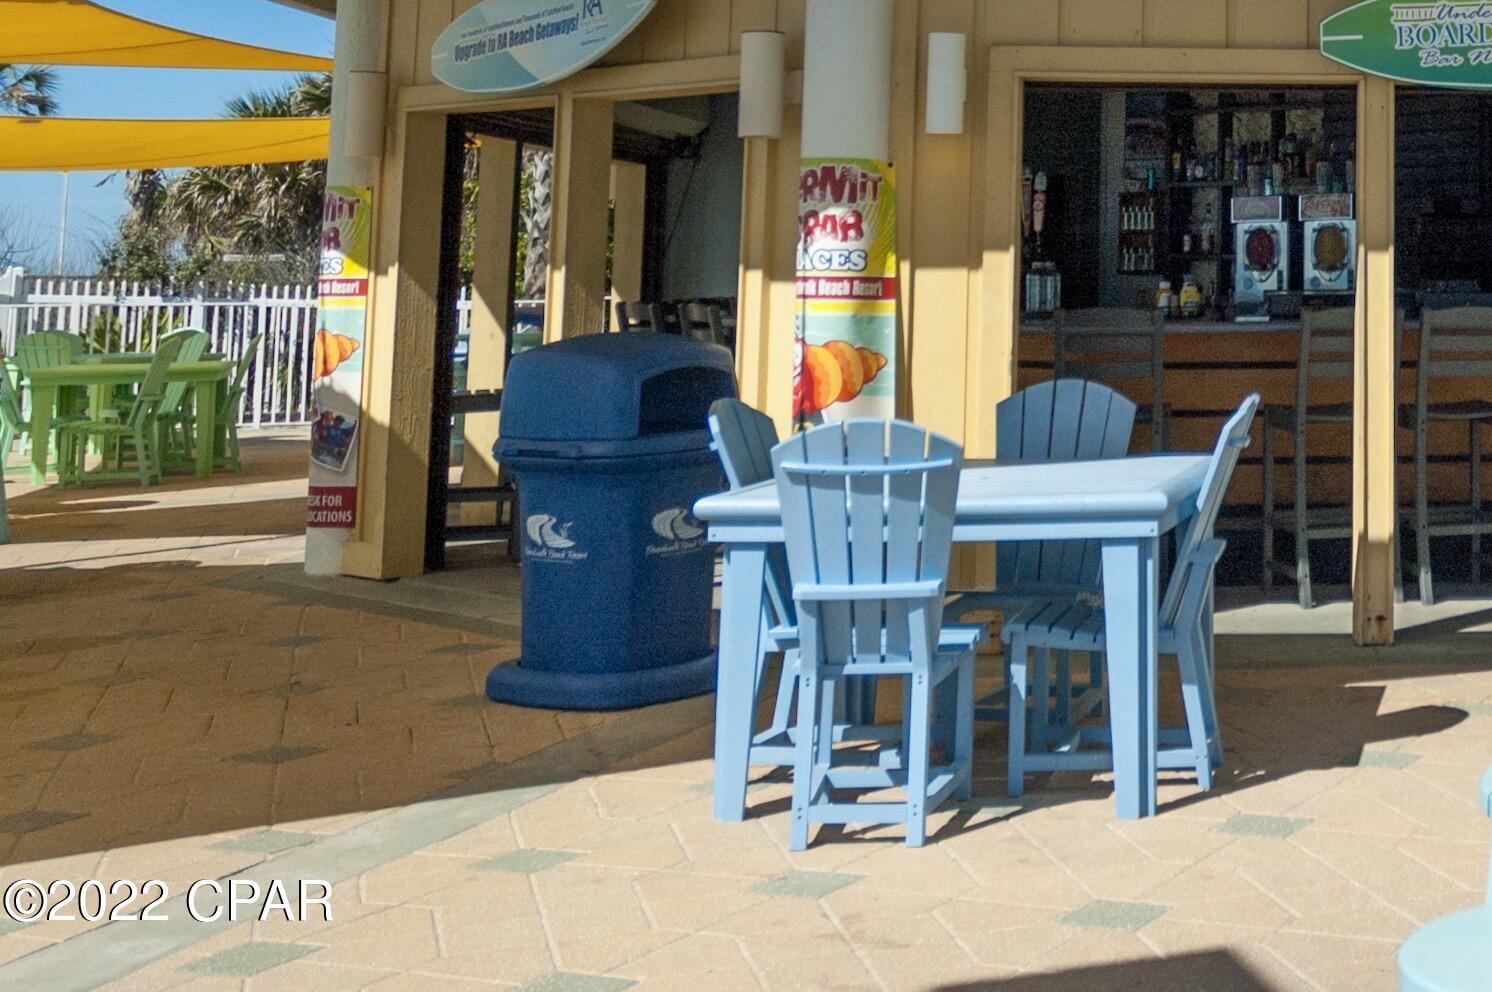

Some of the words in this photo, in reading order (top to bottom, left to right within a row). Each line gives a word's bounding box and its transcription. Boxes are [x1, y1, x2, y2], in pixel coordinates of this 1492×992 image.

[454, 39, 487, 63] Upgrade
[488, 37, 496, 54] to
[497, 32, 508, 51] RA
[508, 25, 535, 48] Beach
[535, 12, 580, 41] Getaways!
[1421, 50, 1463, 67] Bar
[798, 209, 865, 245] RAB
[331, 280, 360, 295] Resort
[817, 278, 851, 296] Beach
[851, 278, 883, 296] Resort
[321, 494, 343, 507] FOR
